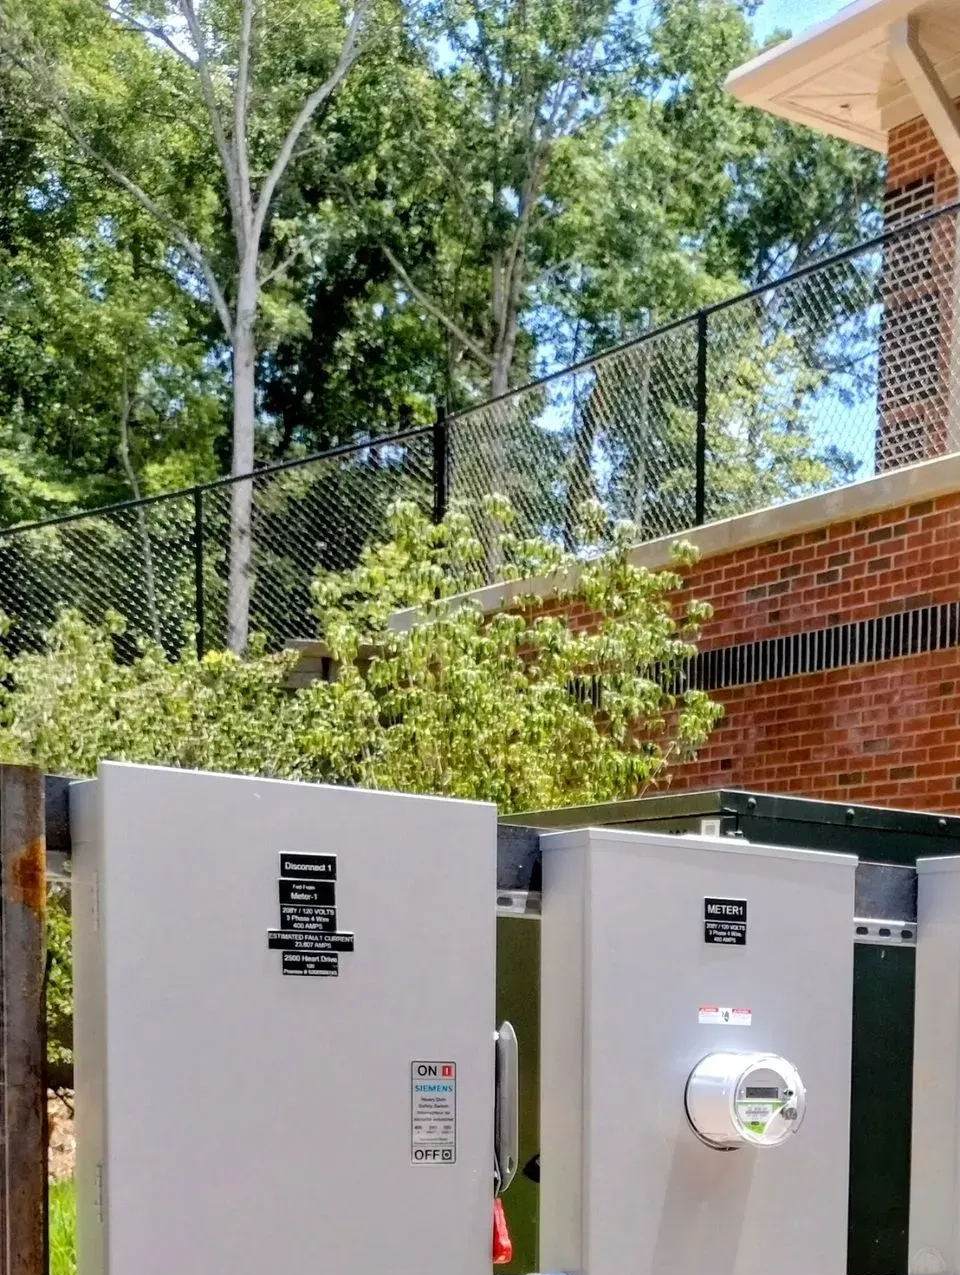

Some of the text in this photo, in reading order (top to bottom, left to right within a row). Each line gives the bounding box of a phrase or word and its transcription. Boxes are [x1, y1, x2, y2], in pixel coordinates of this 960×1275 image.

[285, 862, 326, 872] Disconnect
[314, 908, 335, 916] VOLTS
[707, 904, 743, 915] METER1
[301, 955, 320, 963] Heart
[417, 1065, 438, 1077] ON
[414, 1149, 440, 1161] OFF
